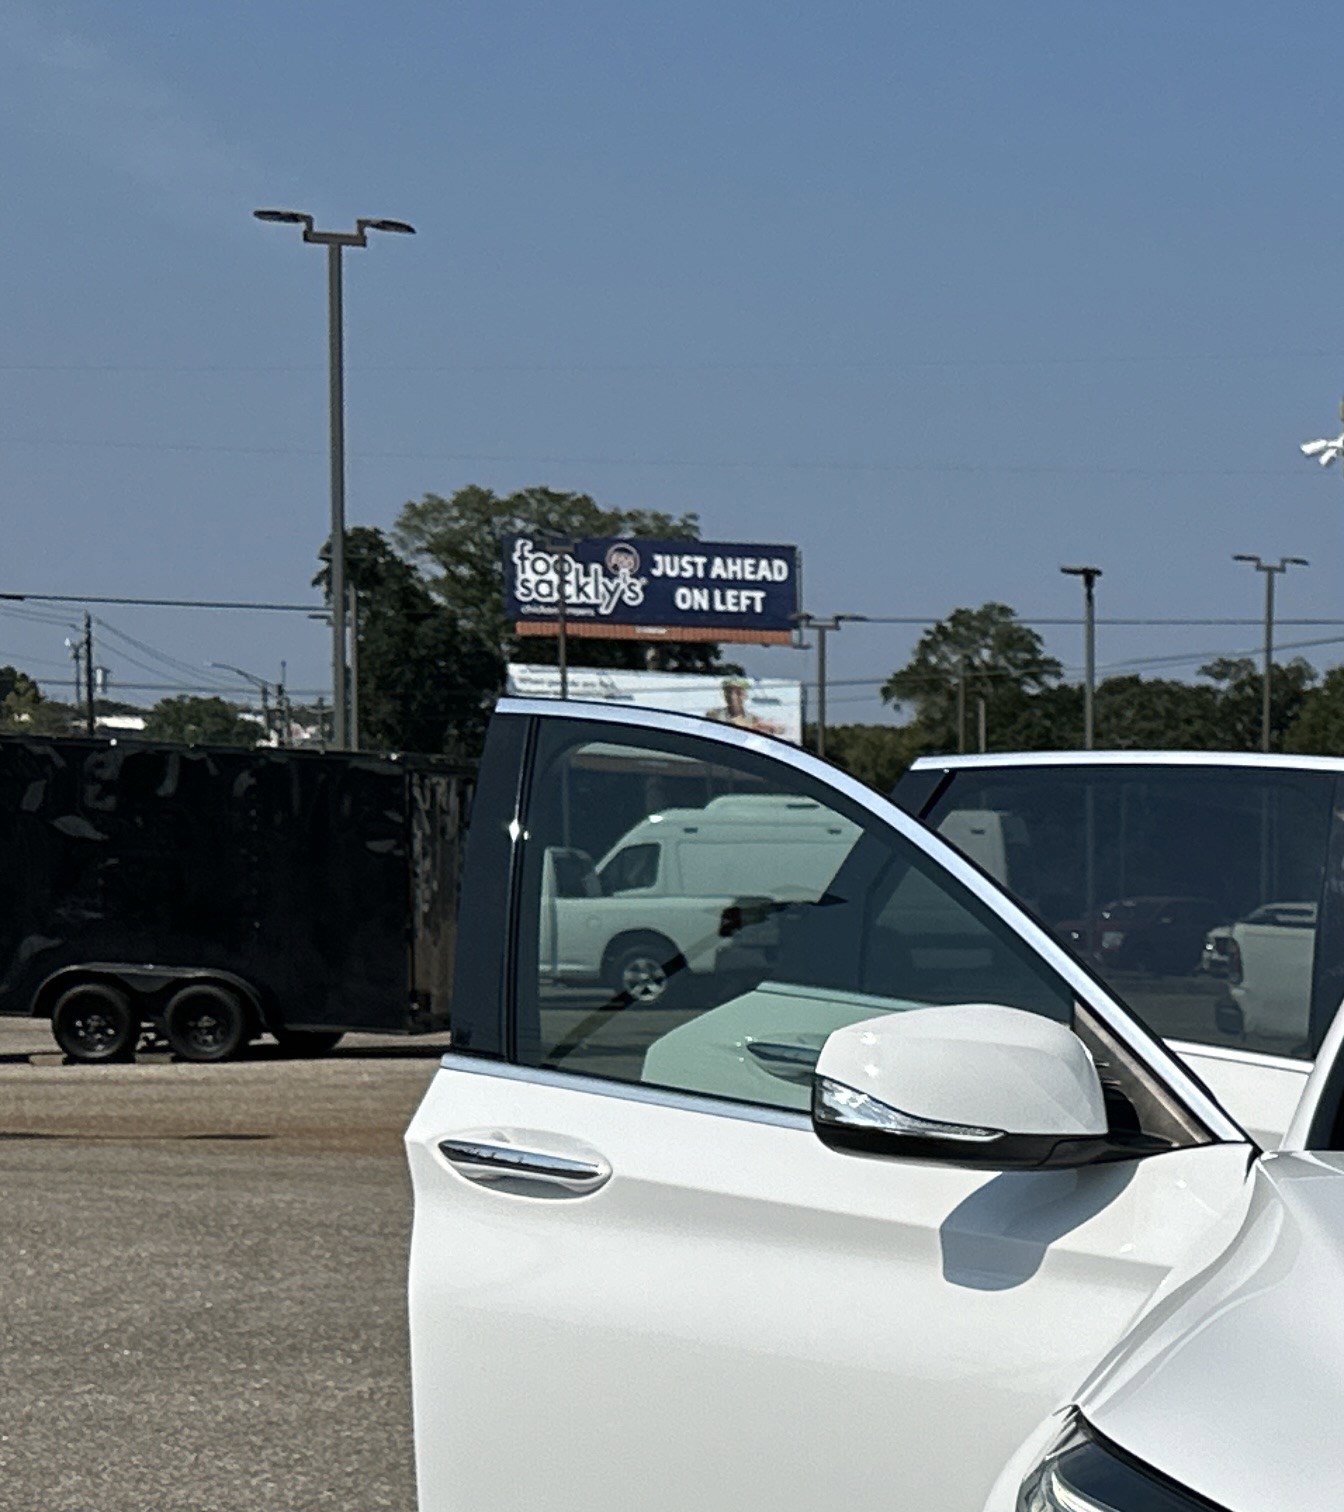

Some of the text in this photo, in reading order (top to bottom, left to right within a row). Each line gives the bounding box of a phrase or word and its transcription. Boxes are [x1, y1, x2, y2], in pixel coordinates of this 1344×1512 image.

[650, 553, 789, 582] JUST AHEAD
[674, 586, 767, 613] ON LEFT
